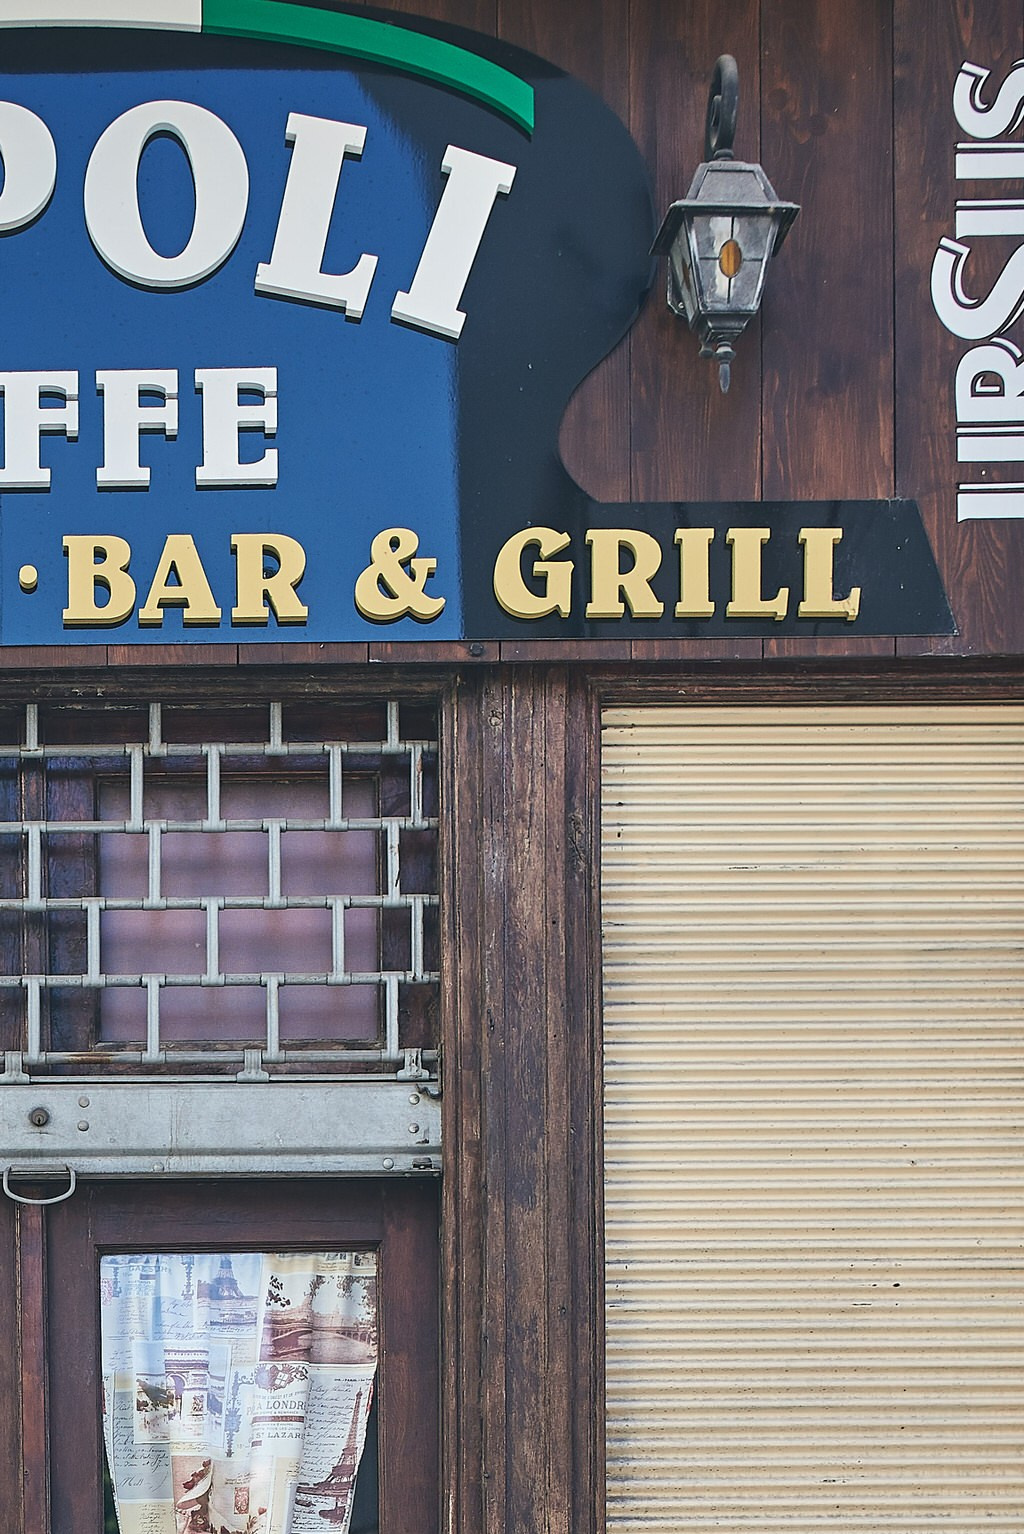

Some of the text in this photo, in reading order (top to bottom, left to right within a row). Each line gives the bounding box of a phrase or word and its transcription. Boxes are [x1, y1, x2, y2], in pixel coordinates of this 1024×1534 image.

[62, 533, 309, 626] BAR
[354, 527, 447, 623] &
[493, 526, 862, 622] GRILL
